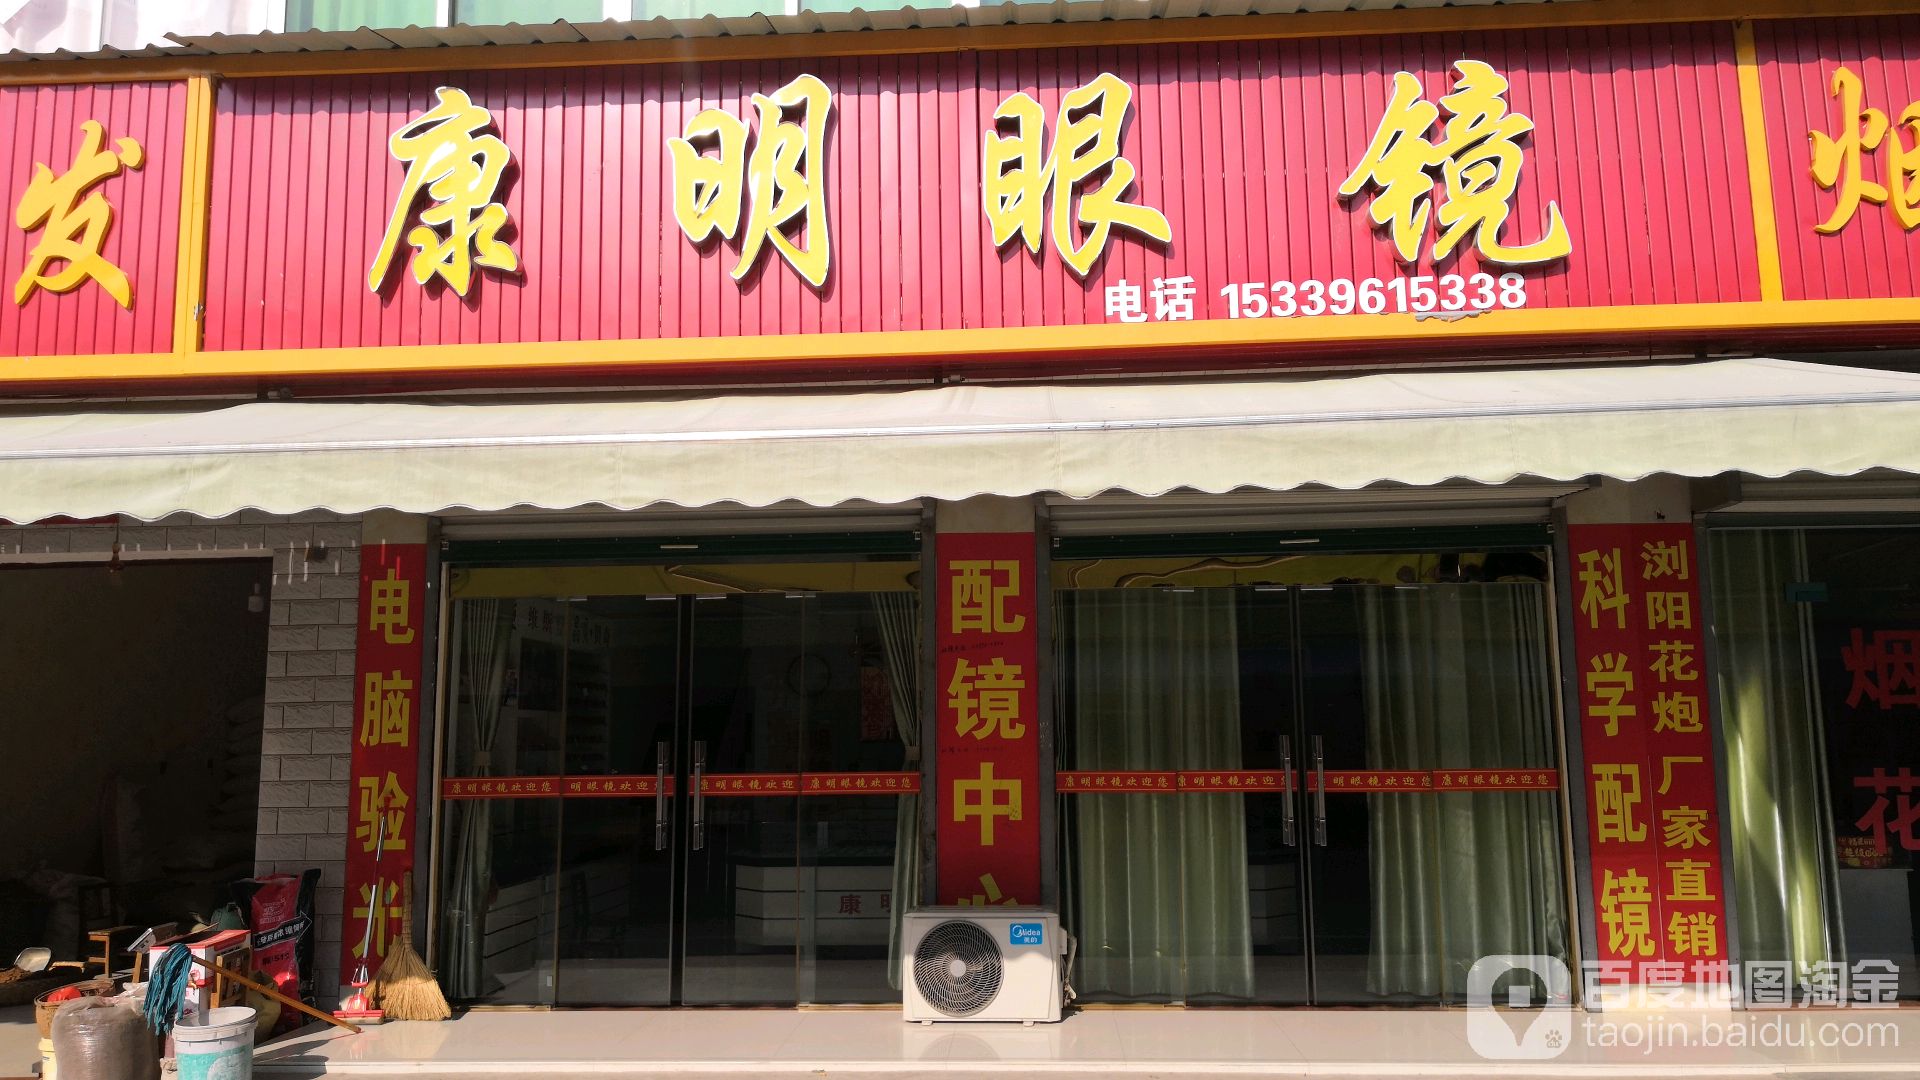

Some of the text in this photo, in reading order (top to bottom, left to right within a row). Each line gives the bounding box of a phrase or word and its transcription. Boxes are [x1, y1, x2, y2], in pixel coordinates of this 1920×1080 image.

[369, 59, 1572, 297] 康明眼镜
[14, 119, 146, 309] 发
[1104, 272, 1528, 323] 电话 15339615338
[1578, 547, 1655, 957] 科学配镜
[1640, 539, 1718, 957] 浏阳花炮厂家直销
[1840, 627, 1920, 854] 烟花
[450, 780, 553, 794] 康明眼镜欢迎您
[570, 780, 660, 792] 明眼镜欢迎
[810, 777, 913, 789] 康明眼镜欢迎您
[1064, 775, 1169, 787] 康明眼镜欢迎您
[1314, 775, 1432, 787] 明眼镜欢迎您
[1441, 774, 1549, 787] 康明眼镜欢迎您
